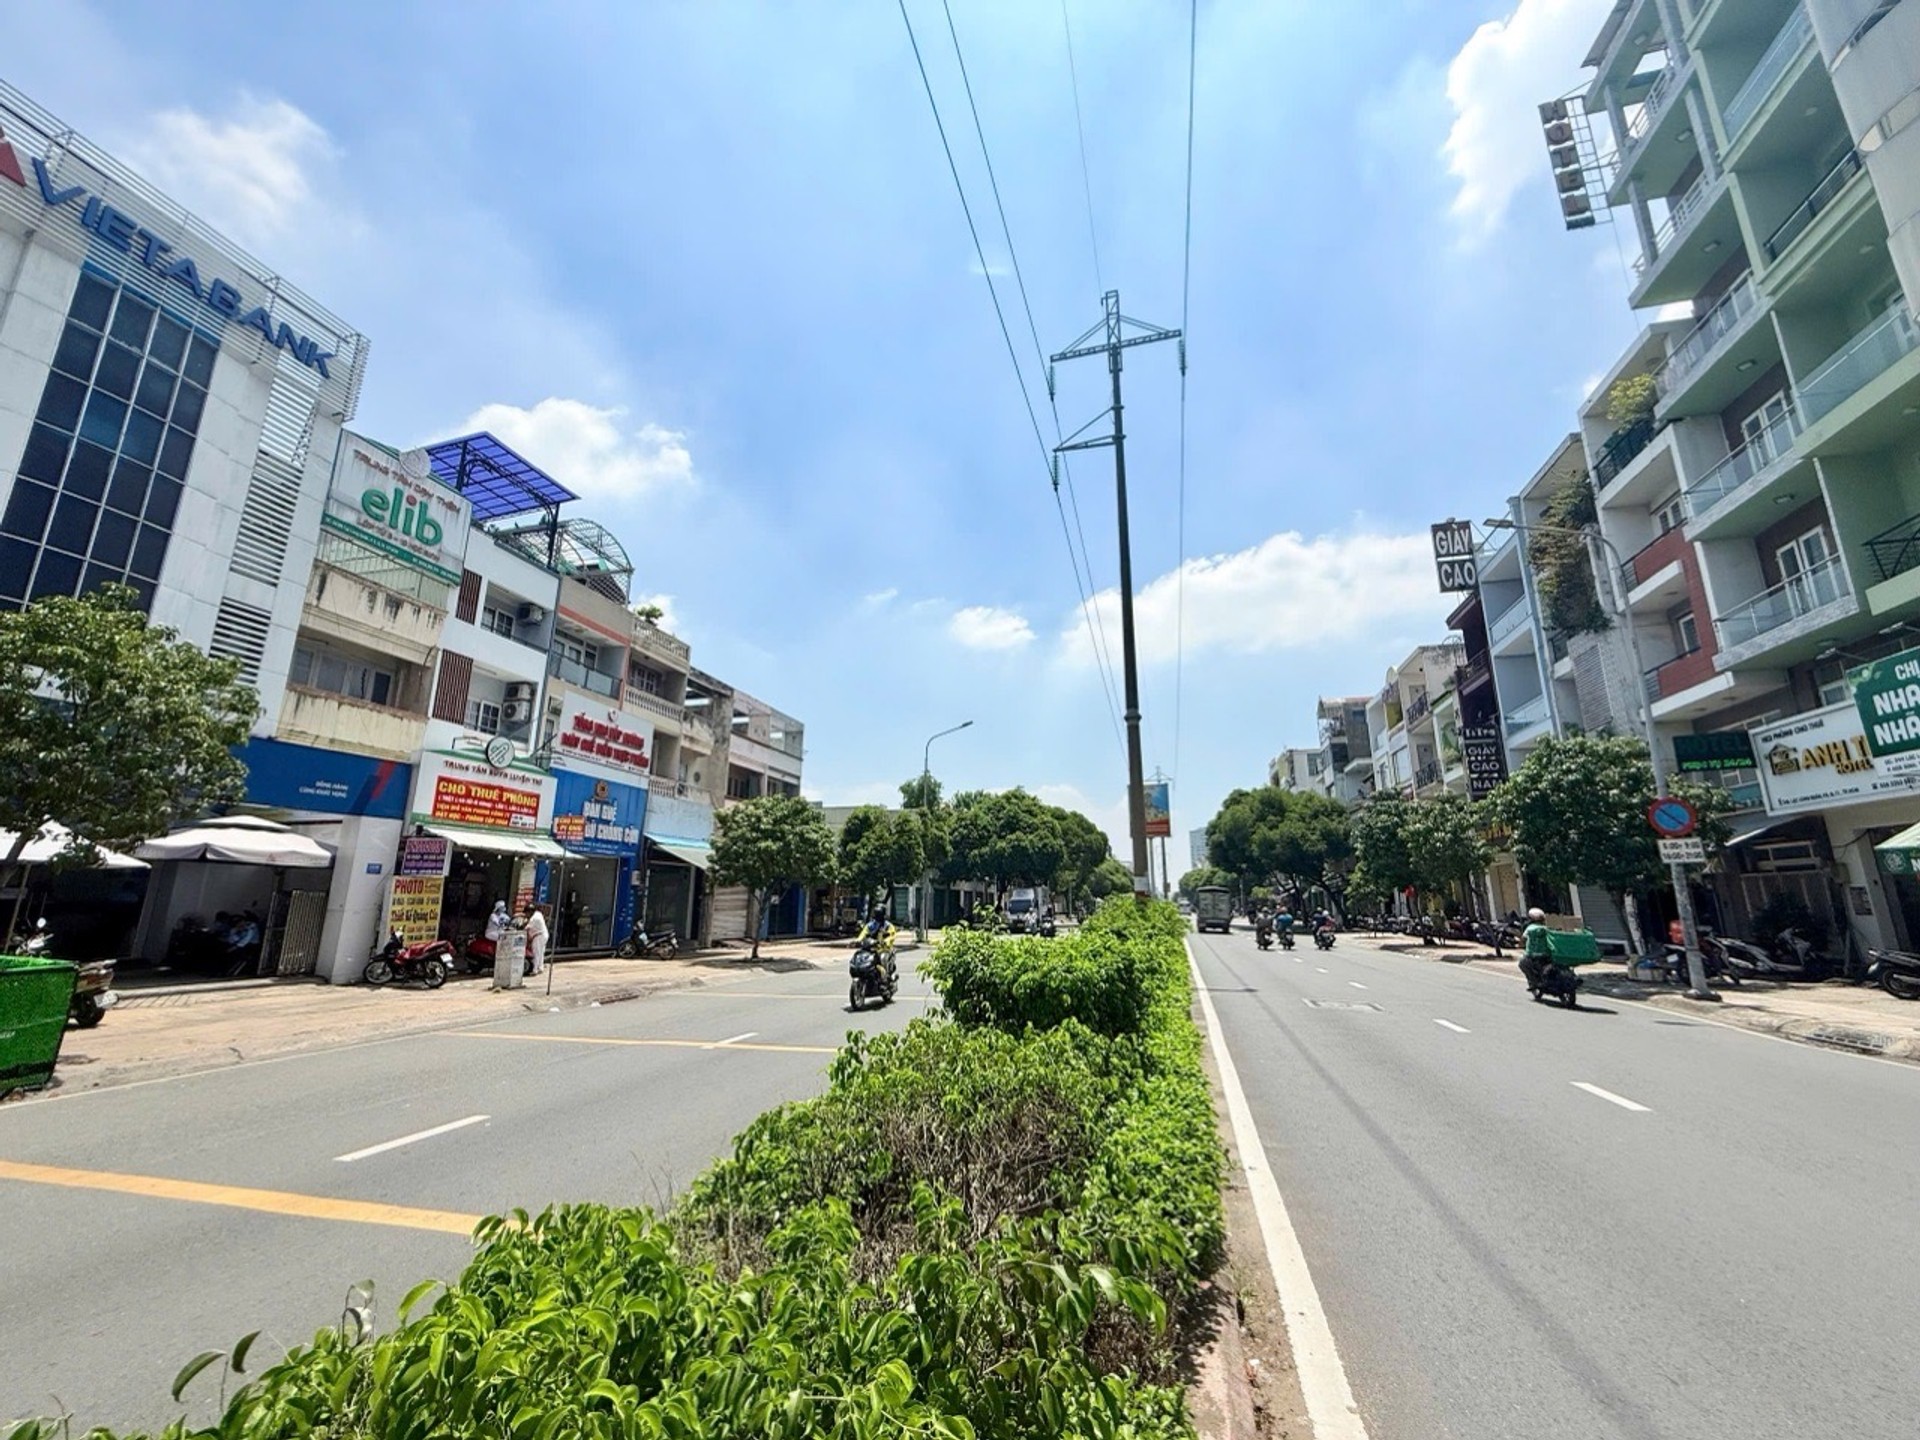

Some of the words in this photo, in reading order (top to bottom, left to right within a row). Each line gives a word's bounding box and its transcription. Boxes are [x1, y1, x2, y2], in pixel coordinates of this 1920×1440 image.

[1540, 101, 1590, 218] HOTEL
[32, 156, 334, 379] VIETABANK
[361, 487, 443, 546] elib
[1435, 523, 1469, 555] GIÀY
[1441, 561, 1476, 588] CAO
[444, 759, 469, 771] TRUNG
[1471, 761, 1500, 772] CAO
[1802, 740, 1851, 770] ANH
[439, 780, 466, 796] CHO
[470, 784, 500, 802] THUÊ
[502, 790, 537, 808] PHÒNG
[394, 879, 424, 895] PHOTO
